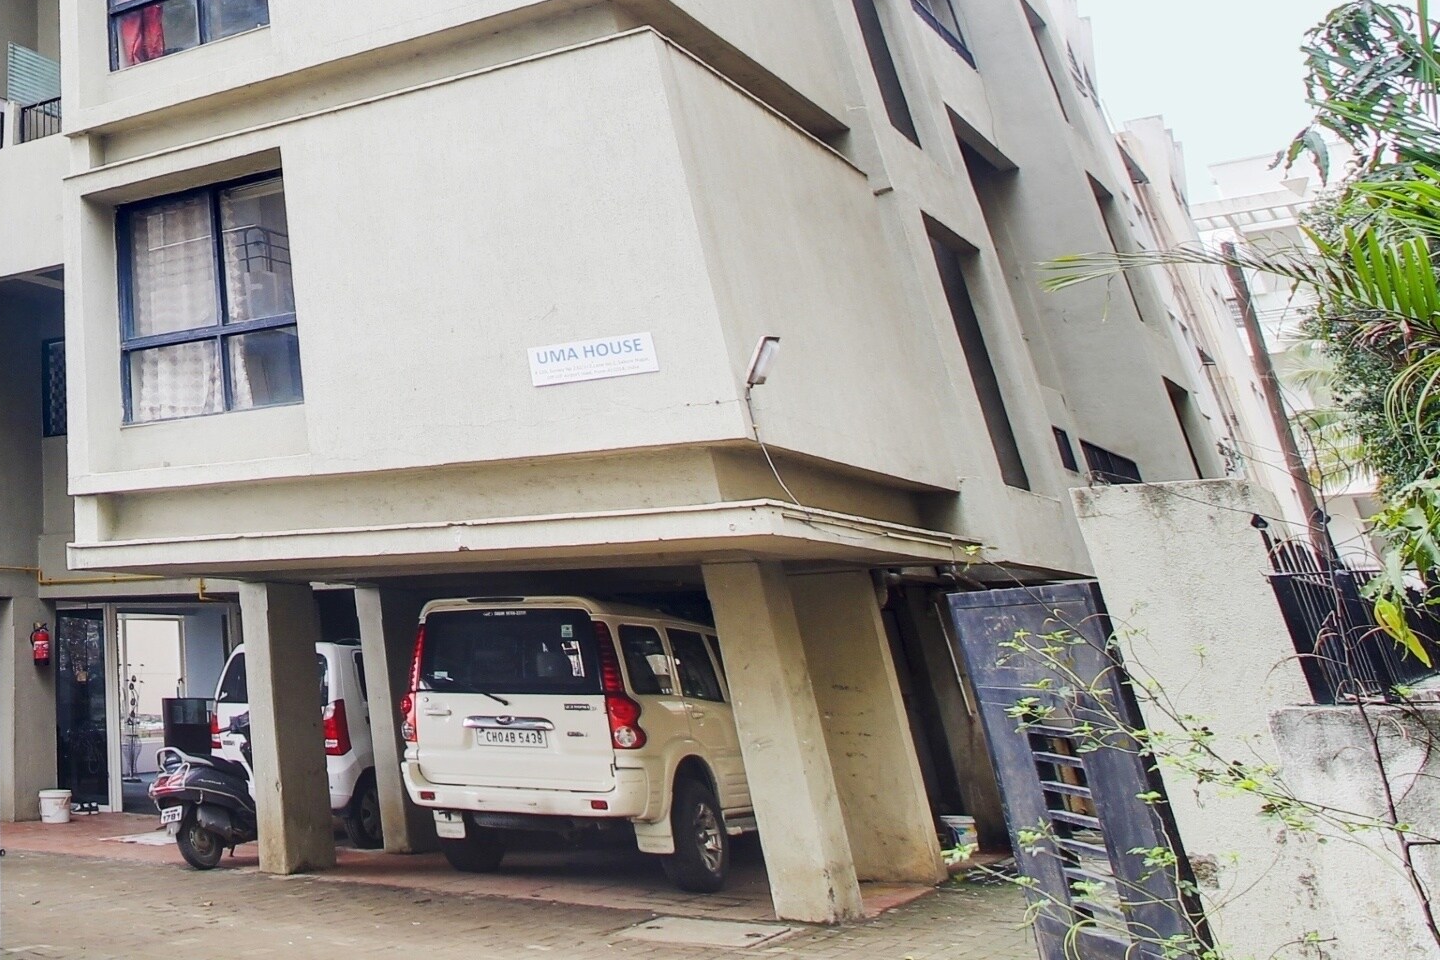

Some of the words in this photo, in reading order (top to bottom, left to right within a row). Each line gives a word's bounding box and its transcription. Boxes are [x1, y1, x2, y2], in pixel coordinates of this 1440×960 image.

[536, 347, 579, 365] UMA
[583, 338, 643, 358] HOUSE
[486, 731, 516, 743] CH04B
